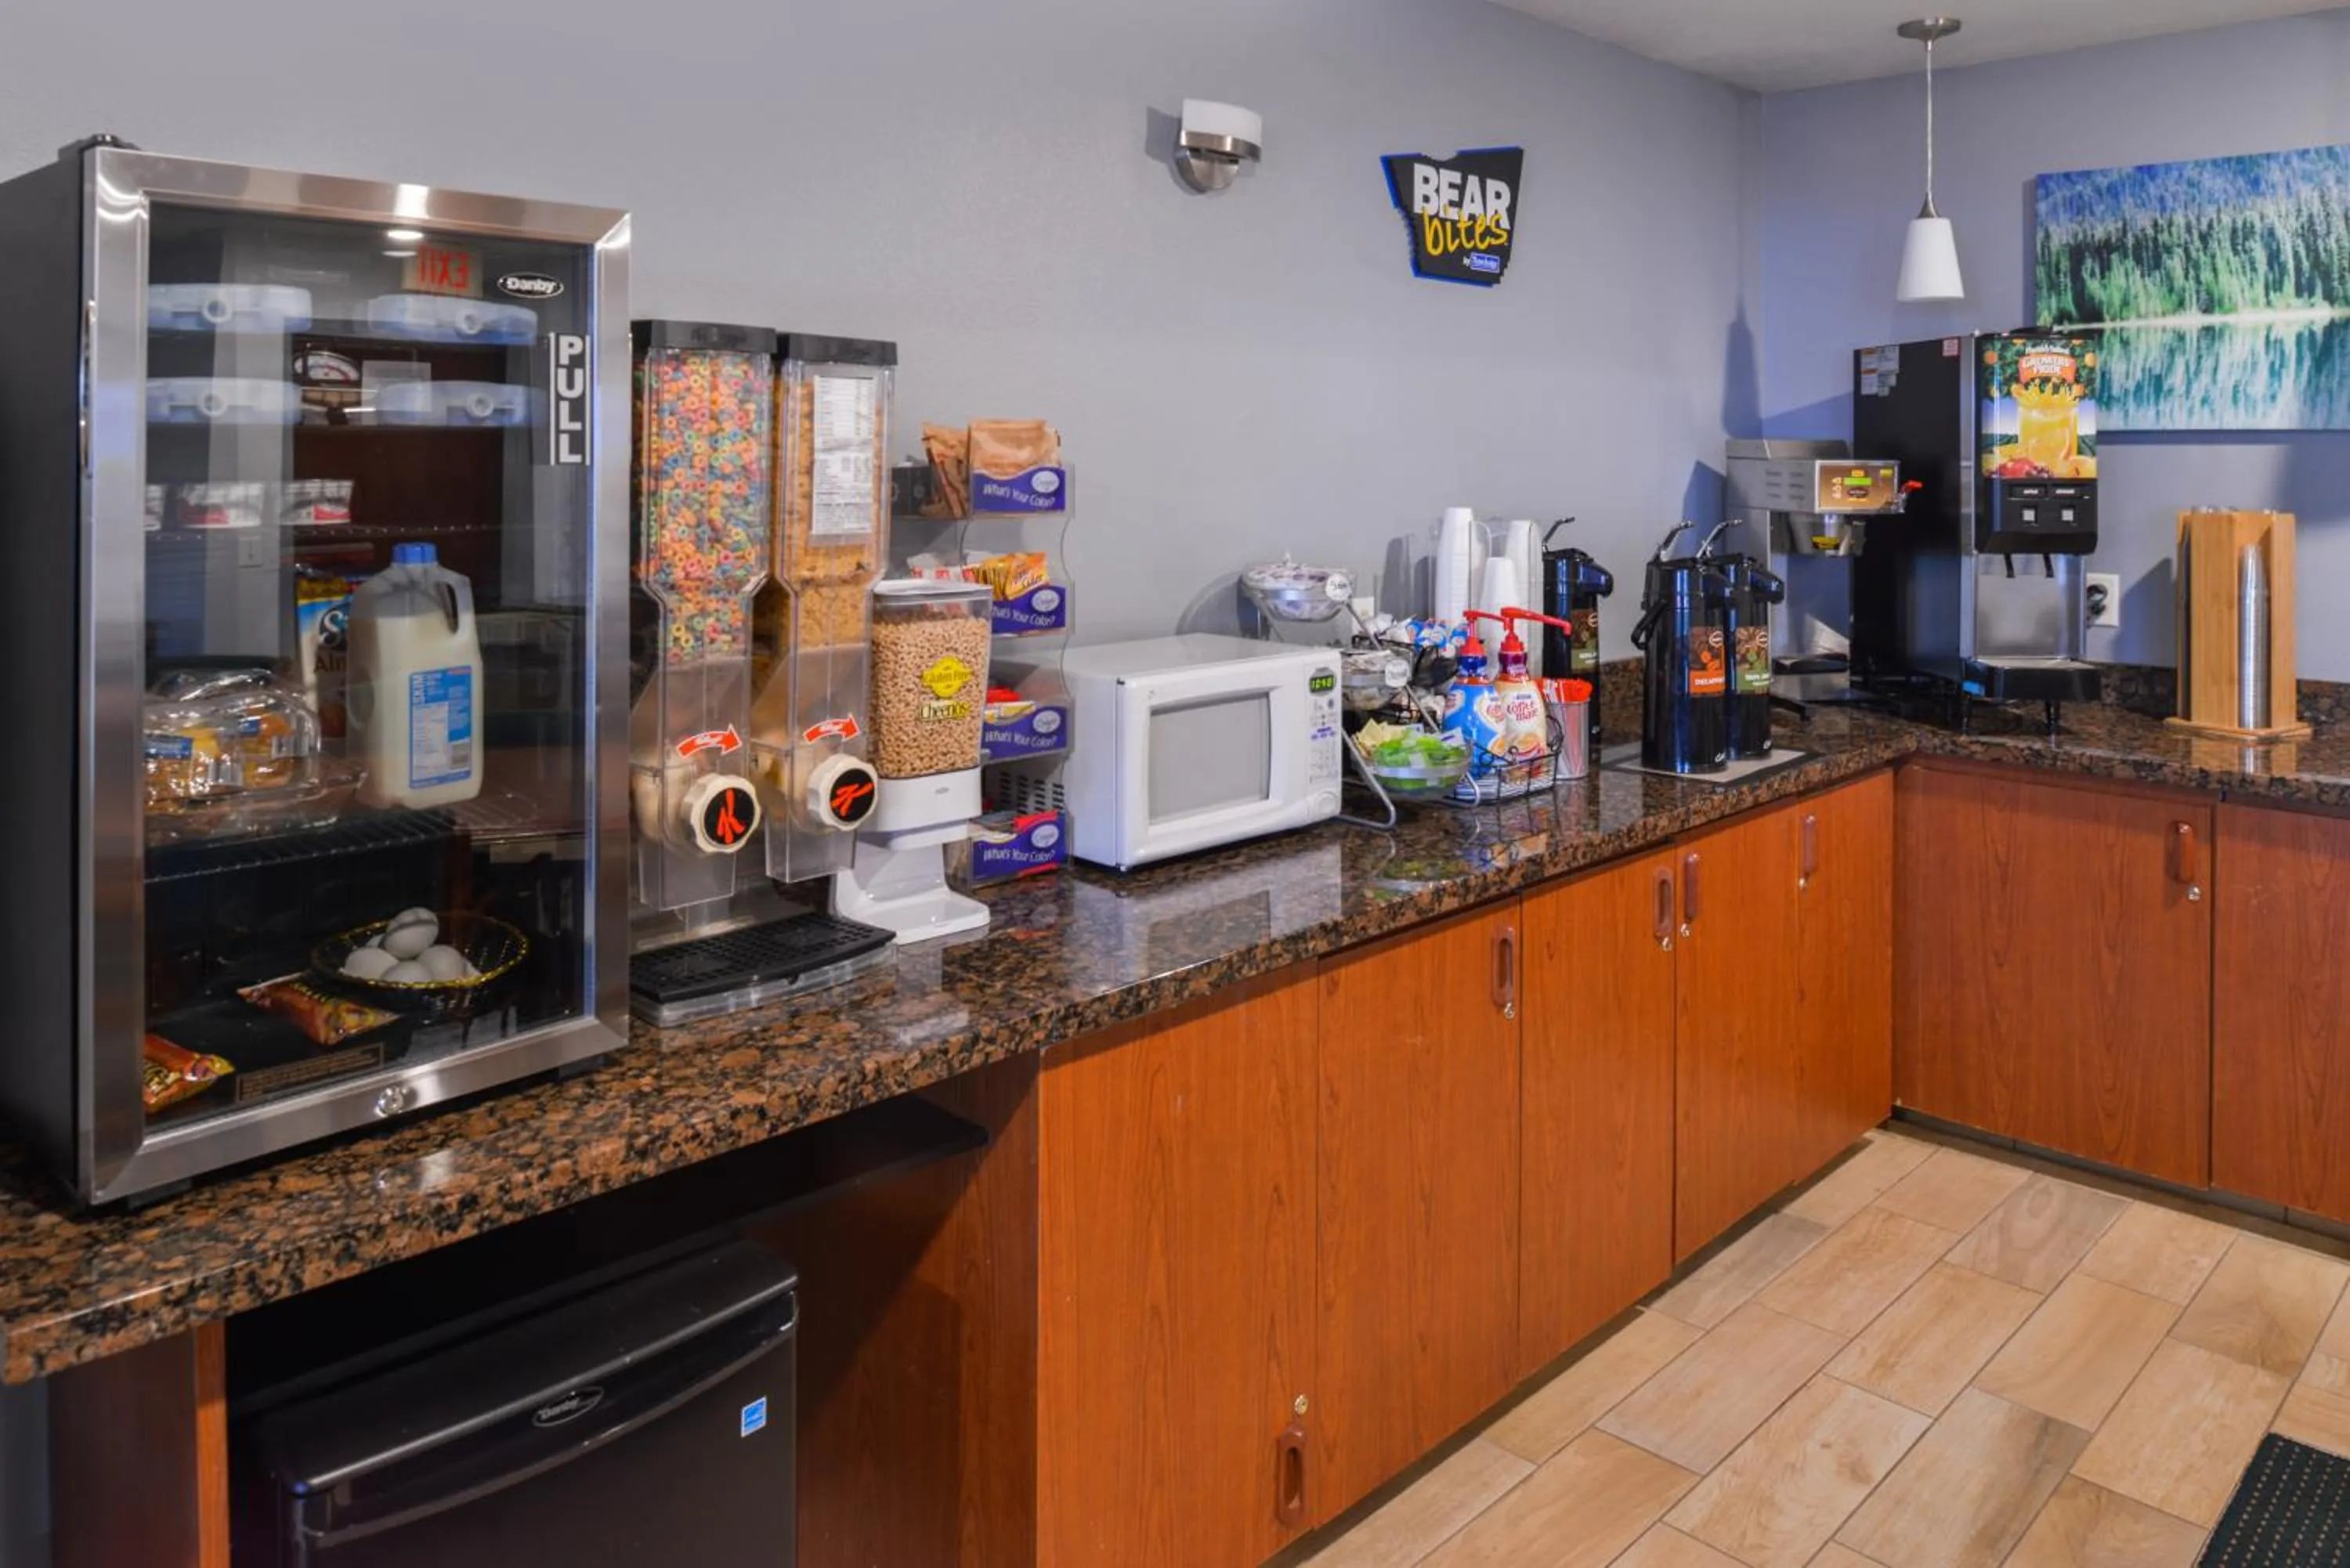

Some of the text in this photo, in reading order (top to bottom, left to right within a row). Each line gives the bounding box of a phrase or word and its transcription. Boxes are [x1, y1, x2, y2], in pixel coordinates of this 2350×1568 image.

[1414, 163, 1511, 229] BEAR
[1422, 206, 1509, 256] bites
[507, 276, 557, 294] Danby
[557, 335, 584, 463] PULL
[982, 483, 1011, 498] What's
[1012, 488, 1029, 504] Your
[992, 606, 1010, 619] hat's
[1012, 610, 1030, 624] Your
